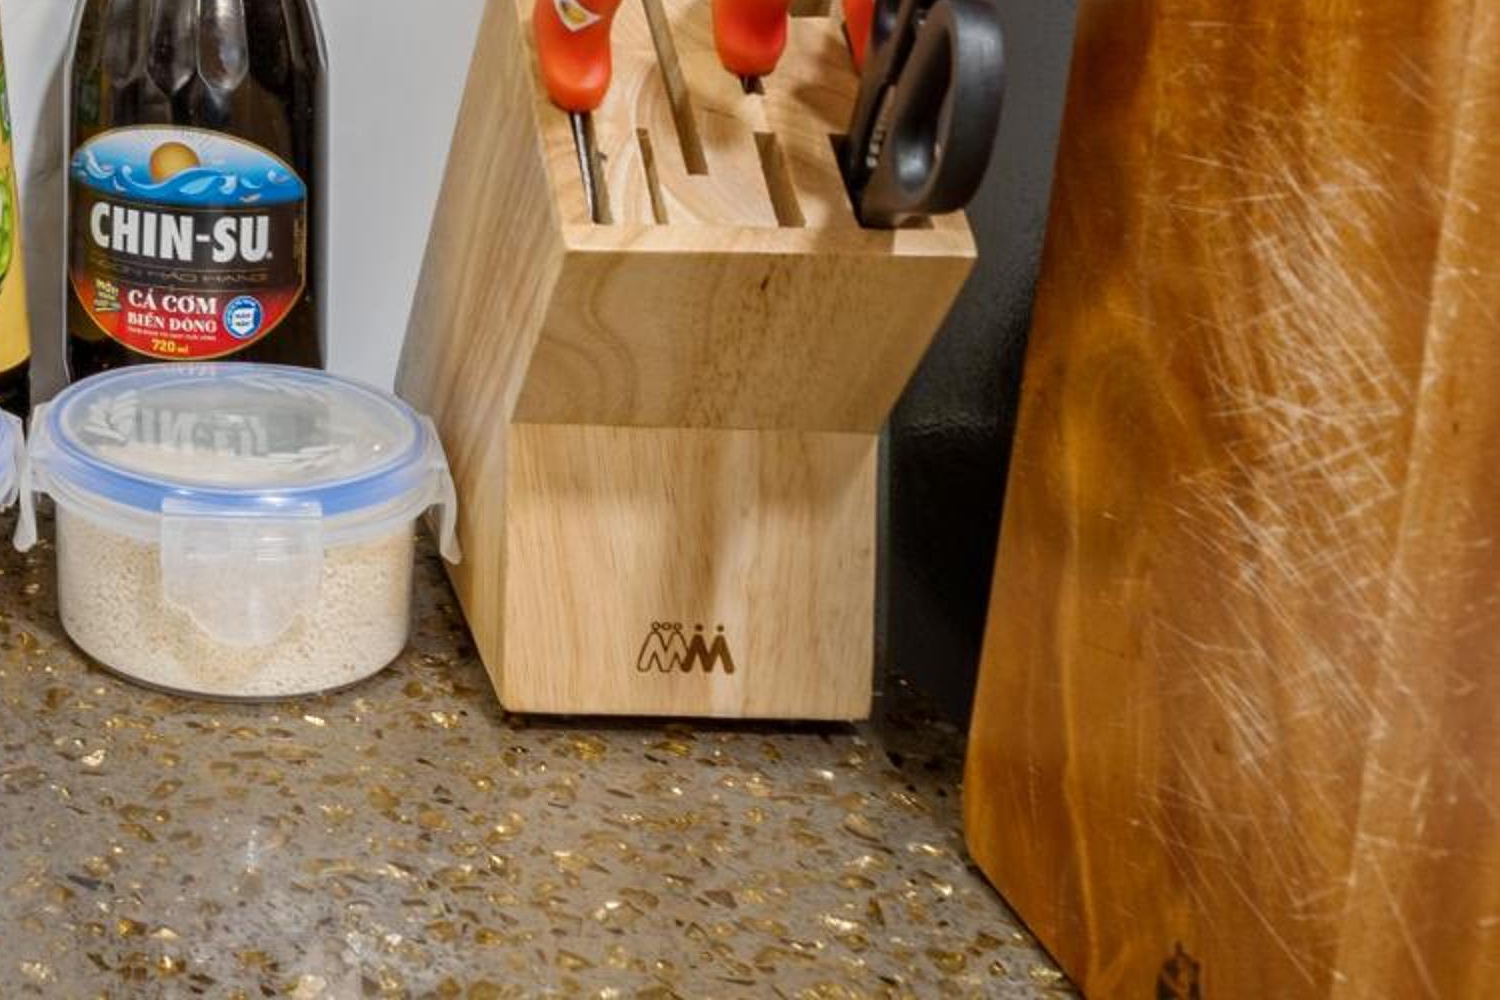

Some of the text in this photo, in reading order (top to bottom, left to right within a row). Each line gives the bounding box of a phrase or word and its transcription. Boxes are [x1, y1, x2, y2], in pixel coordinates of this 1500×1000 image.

[90, 201, 269, 263] CHIN-SU
[128, 288, 157, 310] CÁ
[162, 293, 217, 315] CƠM
[151, 337, 176, 353] 720
